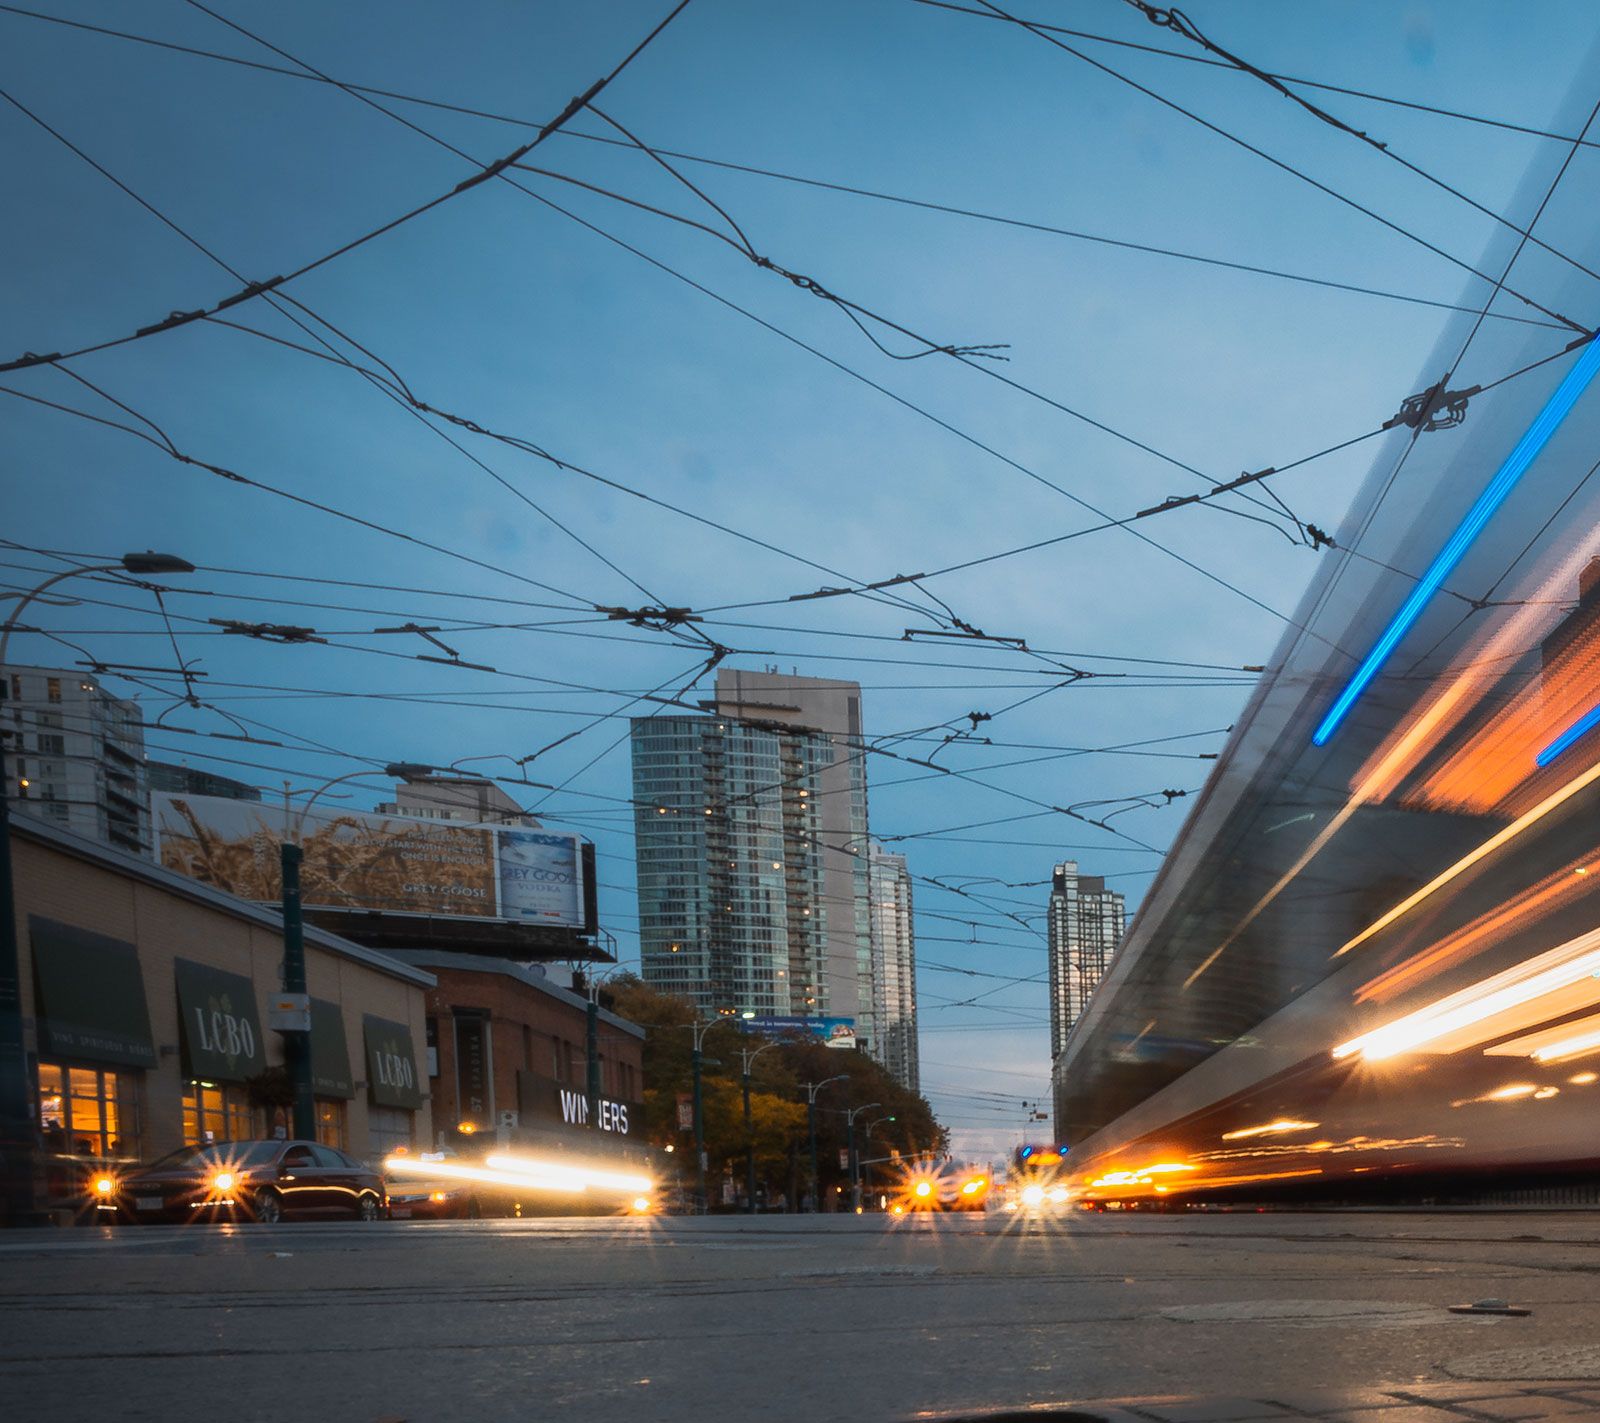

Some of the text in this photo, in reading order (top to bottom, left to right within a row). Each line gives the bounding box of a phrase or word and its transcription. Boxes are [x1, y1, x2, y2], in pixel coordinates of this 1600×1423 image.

[402, 883, 488, 899] GREY GOOSE
[518, 883, 561, 893] VODKA
[194, 1006, 255, 1059] LCBO
[376, 1051, 413, 1089] LCBO
[470, 1095, 483, 1112] 57
